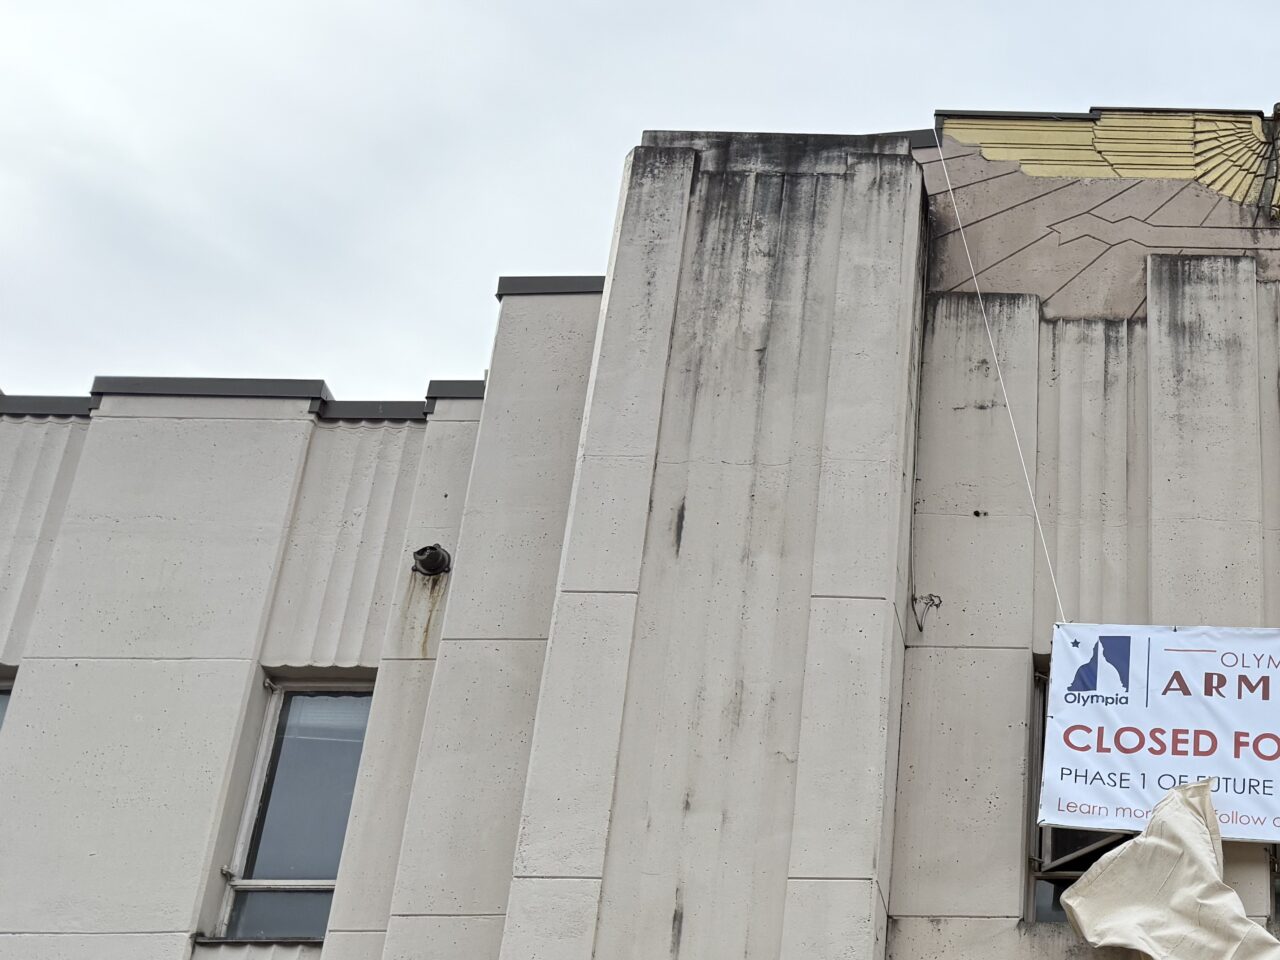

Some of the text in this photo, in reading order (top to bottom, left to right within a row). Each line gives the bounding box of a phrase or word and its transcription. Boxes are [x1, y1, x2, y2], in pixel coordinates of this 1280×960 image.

[1063, 691, 1130, 707] Olympia
[1062, 724, 1218, 757] CLOSED
[1060, 766, 1131, 790] PHASE
[1140, 772, 1146, 790] 1
[1057, 796, 1109, 817] Learn
[1115, 807, 1152, 820] mor
